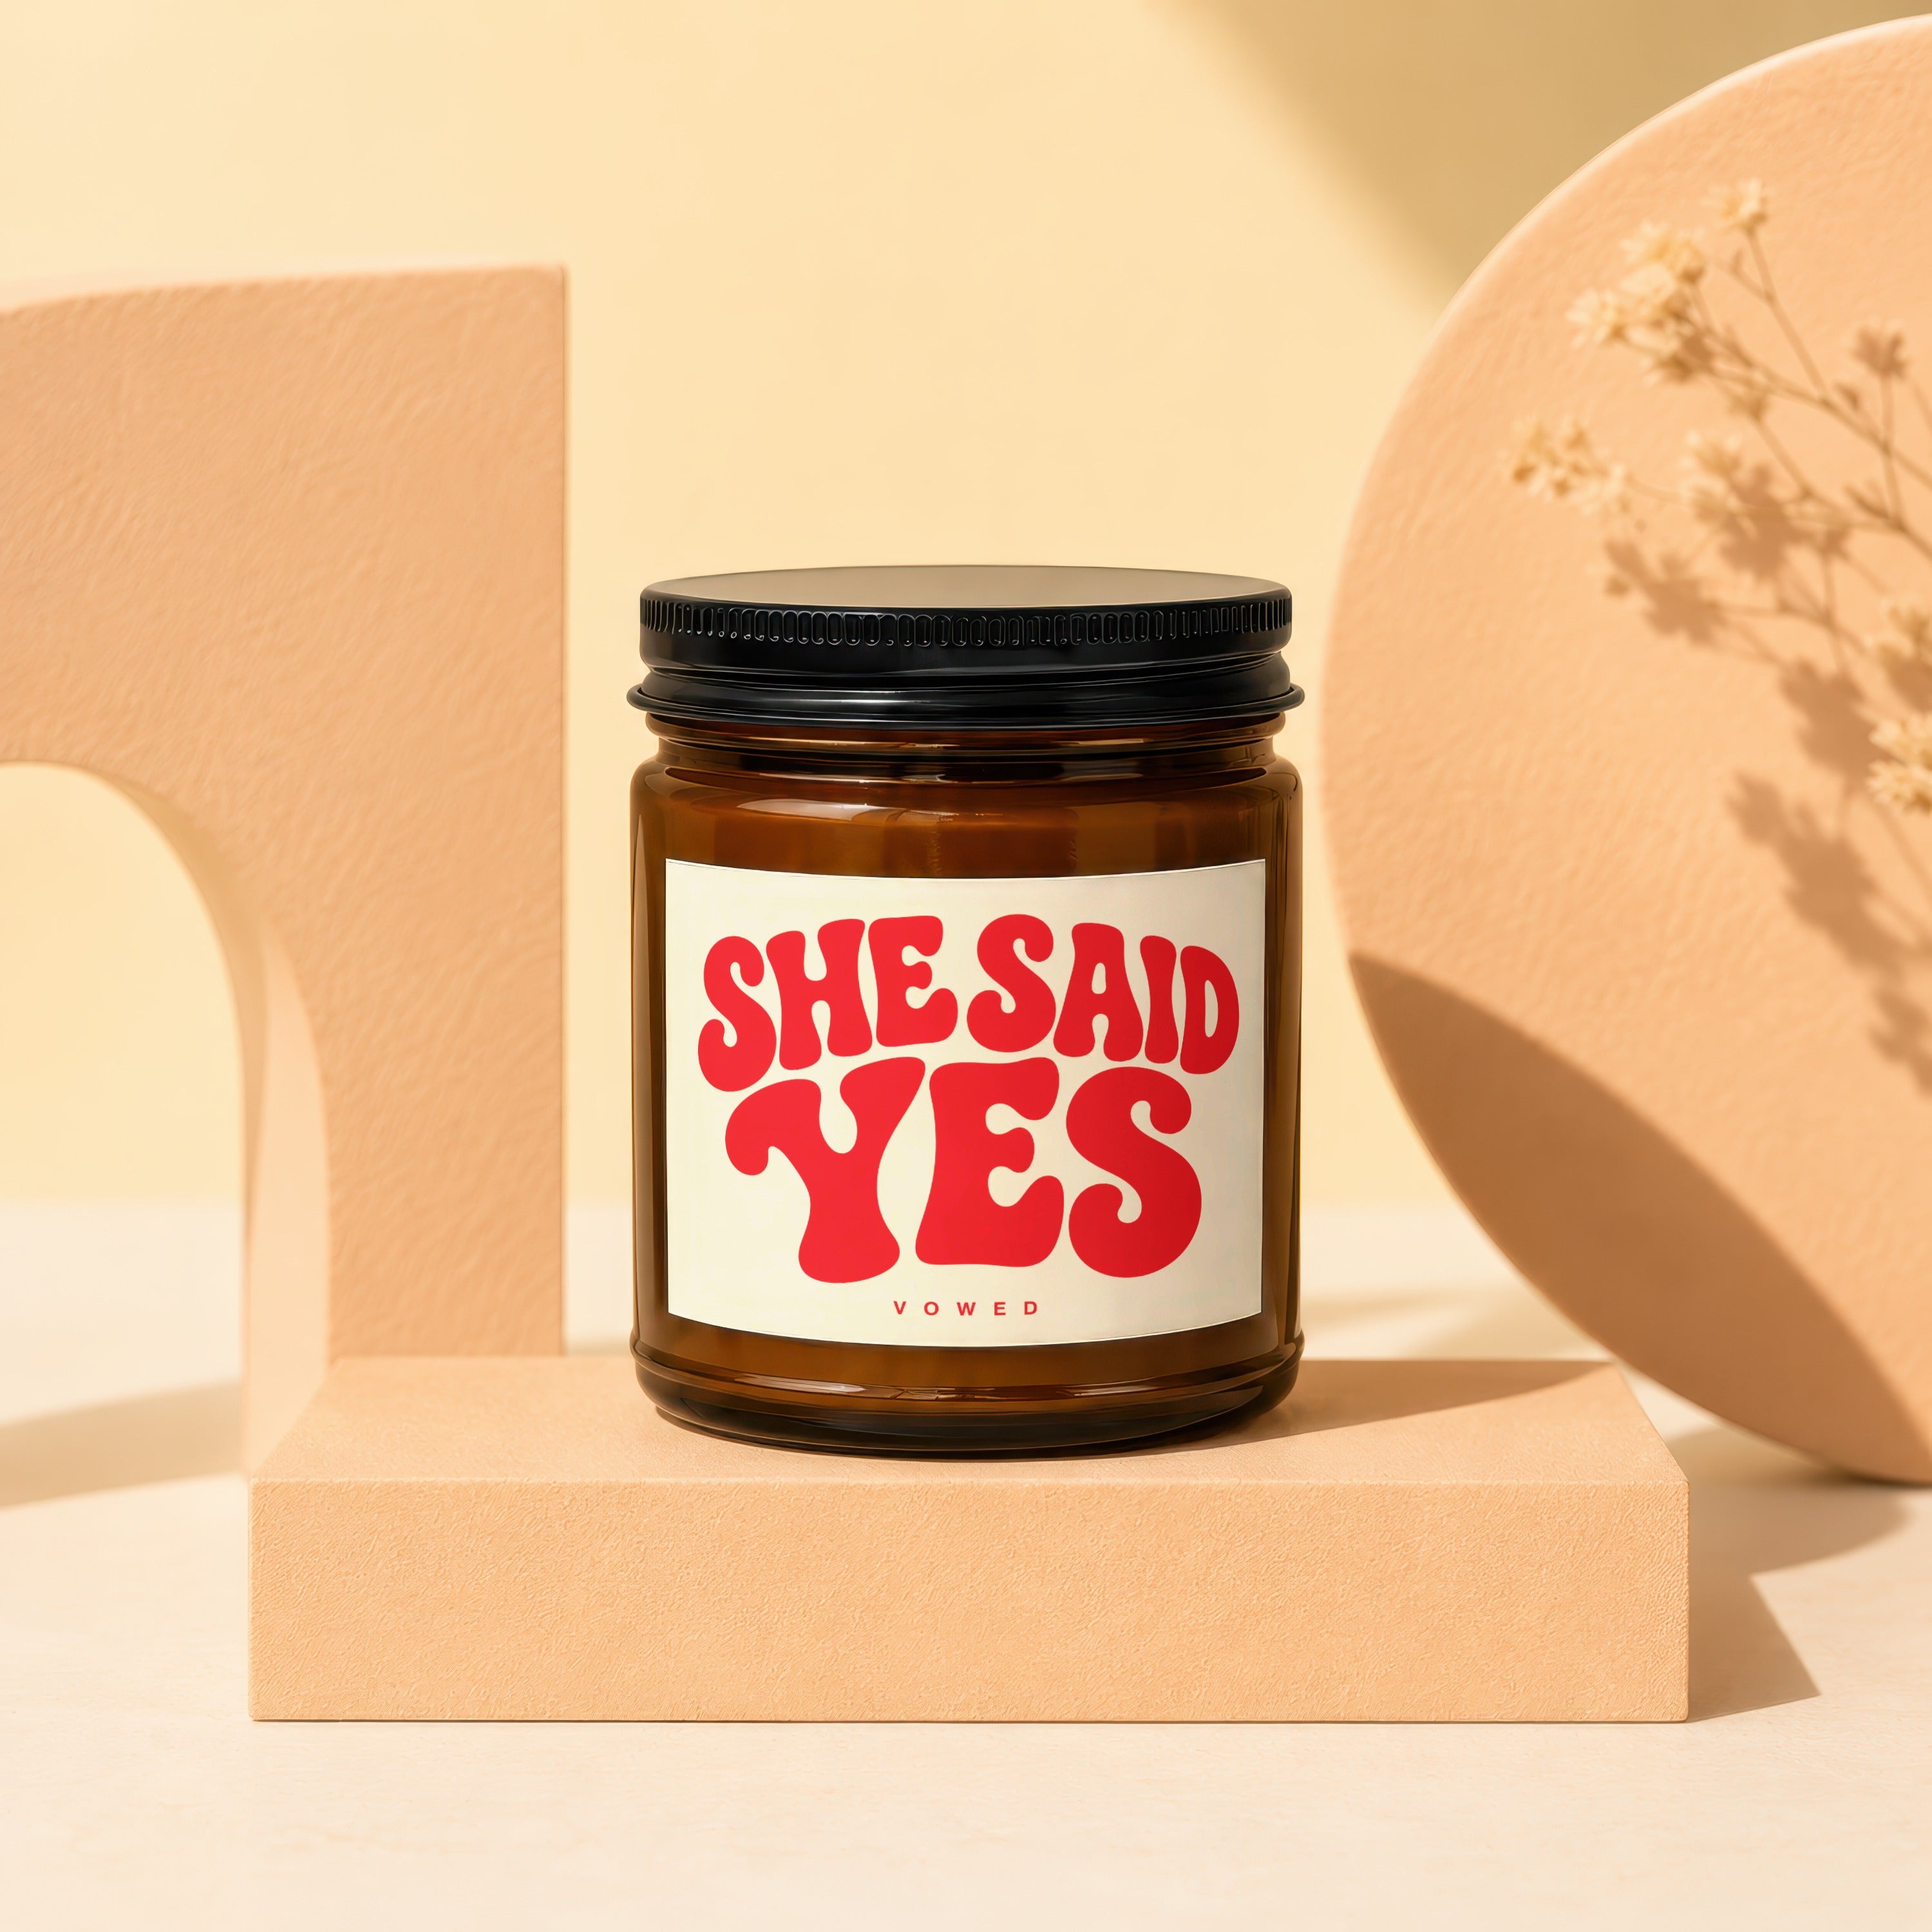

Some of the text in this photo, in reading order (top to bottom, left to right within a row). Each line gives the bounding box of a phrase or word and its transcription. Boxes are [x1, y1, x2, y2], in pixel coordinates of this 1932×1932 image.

[697, 914, 1240, 1092] SHE SAID
[724, 1056, 1202, 1283] YES
[893, 1300, 1039, 1316] VOWED
